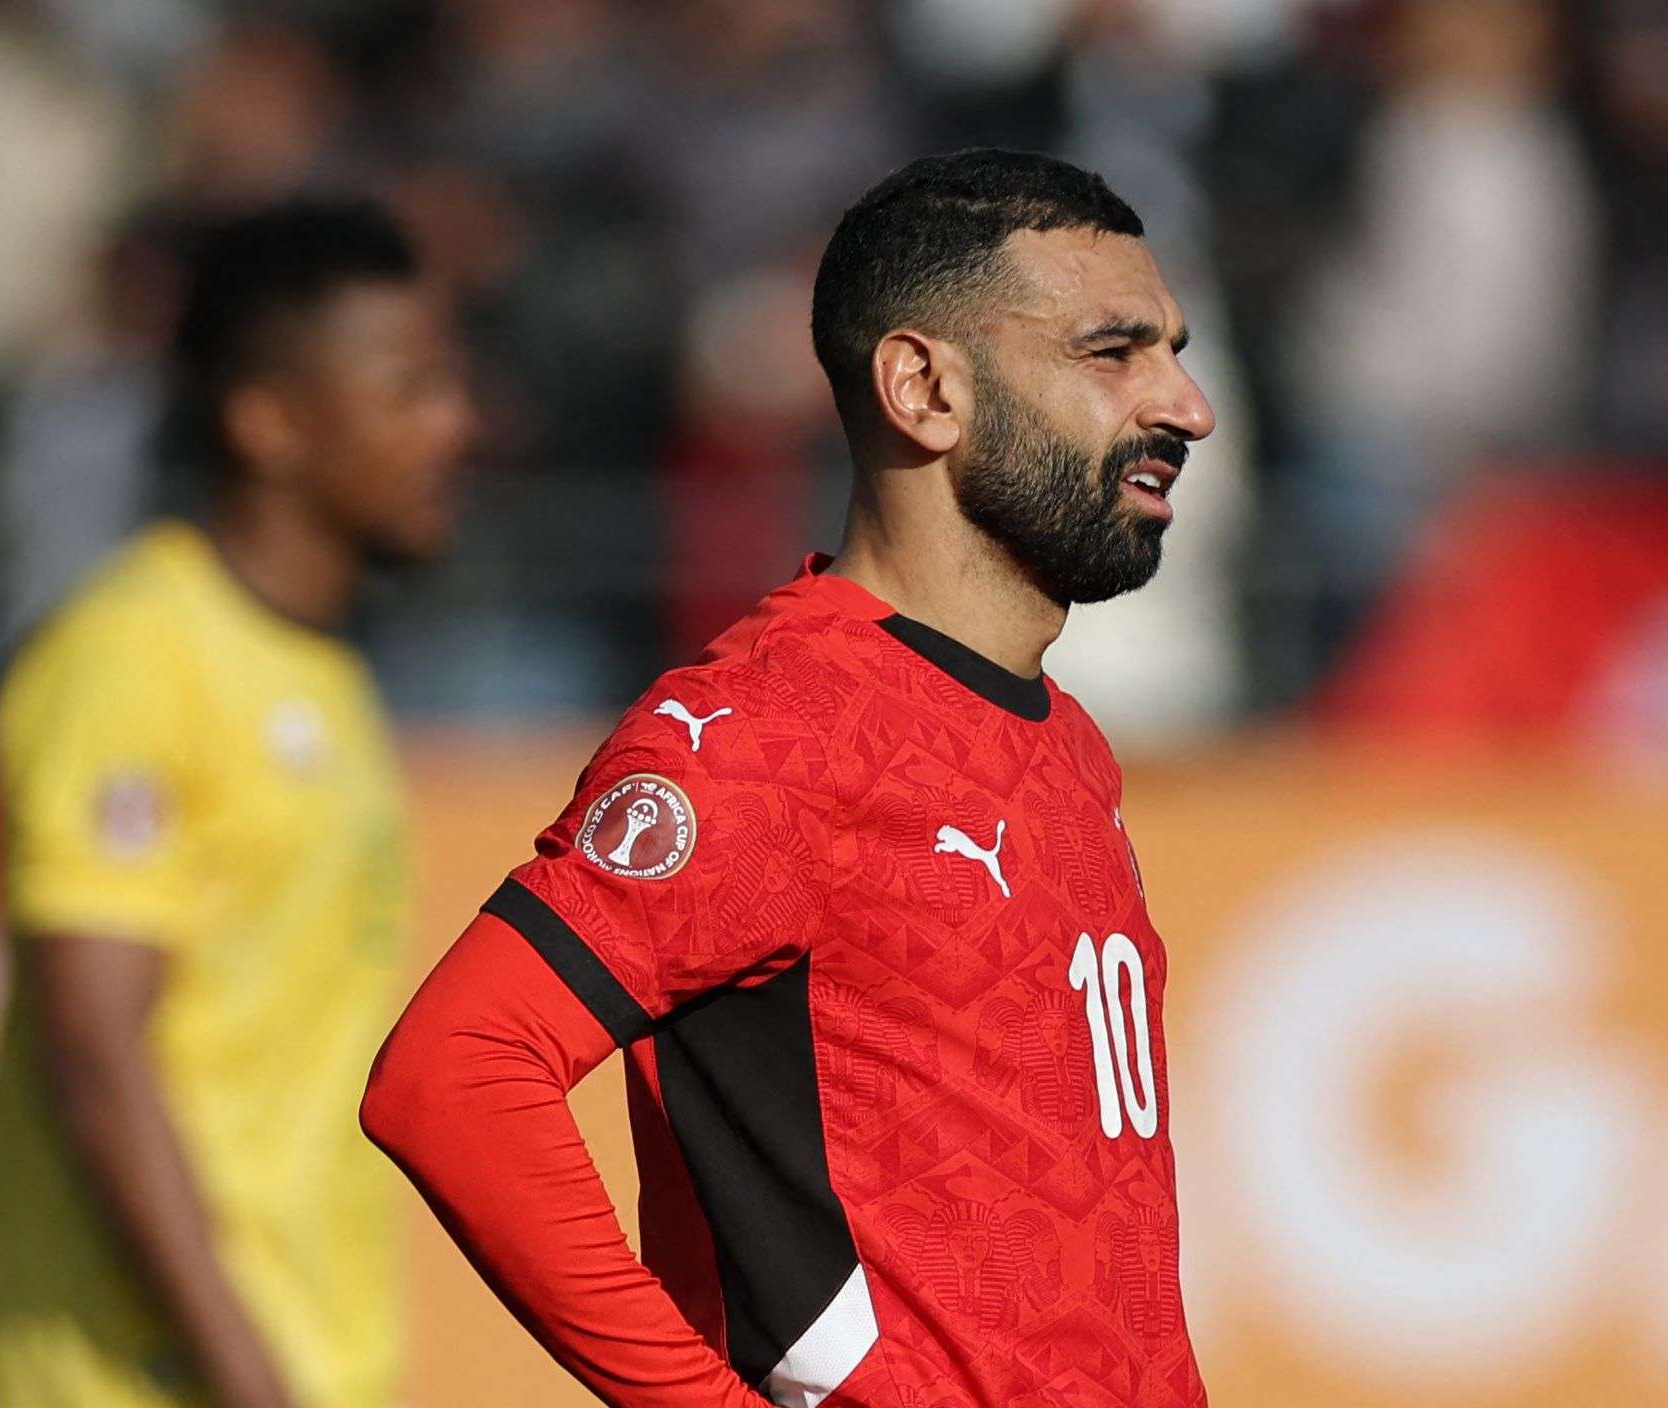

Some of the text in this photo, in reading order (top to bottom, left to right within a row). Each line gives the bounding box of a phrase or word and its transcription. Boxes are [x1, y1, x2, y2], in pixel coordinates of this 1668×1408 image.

[601, 783, 632, 810] CAF
[656, 787, 687, 825] AFRICA
[592, 807, 604, 823] 25
[675, 825, 688, 851] CUP
[613, 862, 667, 877] NATIONS
[665, 851, 680, 869] OF
[1068, 931, 1158, 1139] 10
